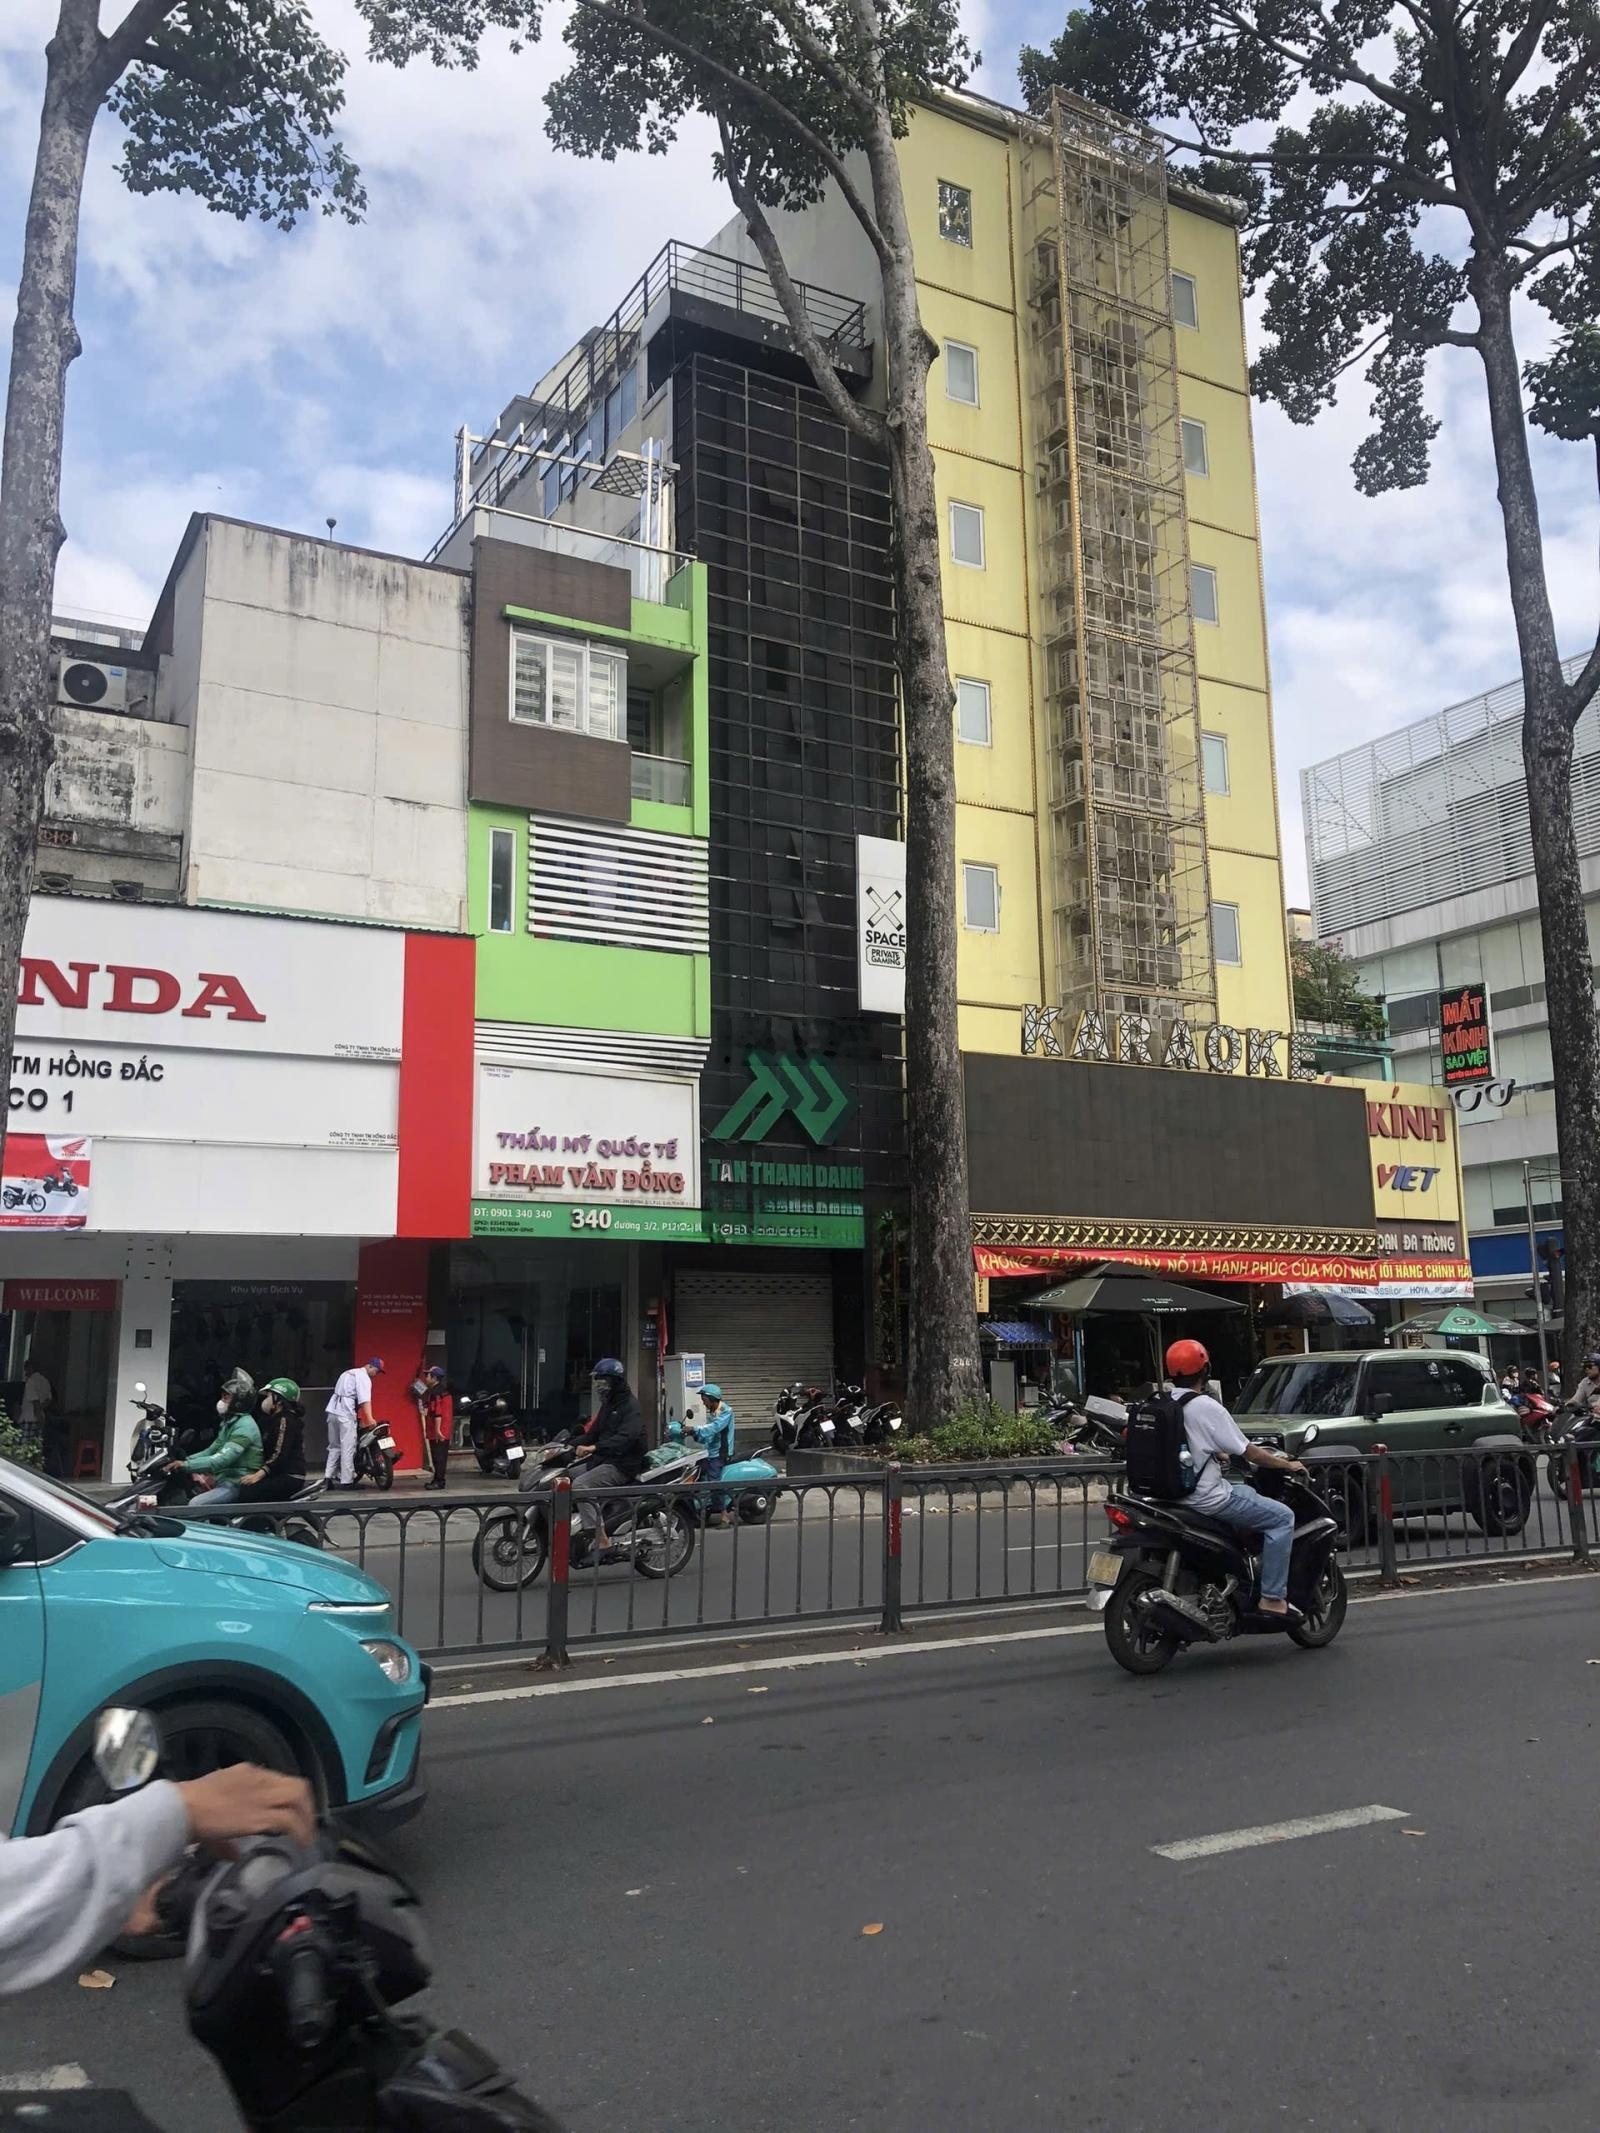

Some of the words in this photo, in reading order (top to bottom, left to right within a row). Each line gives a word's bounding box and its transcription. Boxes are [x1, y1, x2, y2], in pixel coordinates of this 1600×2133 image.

[866, 930, 905, 947] SPACE
[871, 949, 900, 959] PRIVATE
[871, 956, 901, 966] GAMING
[17, 957, 267, 1022] NDA
[1021, 1003, 1317, 1080] KARAOKE
[1443, 1024, 1488, 1054] KÍNH
[120, 1055, 164, 1082] ĐẮC
[1446, 1054, 1465, 1070] SAO
[1467, 1048, 1488, 1067] VIỆT
[62, 1090, 74, 1112] 1
[1367, 1086, 1446, 1142] KÍNH
[562, 1134, 592, 1153] MỸ
[597, 1135, 651, 1158] QUỐC
[655, 1138, 679, 1160] TẾ
[489, 1162, 565, 1191] PHẠM
[568, 1161, 618, 1190] VĂN
[750, 1162, 813, 1188] THANH
[815, 1165, 864, 1190] DANH
[474, 1208, 489, 1217] ĐT:
[490, 1208, 513, 1218] 0901
[516, 1209, 533, 1218] 340
[535, 1209, 552, 1219] 340
[571, 1208, 612, 1231] 340
[1403, 1234, 1418, 1251] ĐA
[1422, 1231, 1456, 1252] TRÒNG
[979, 1251, 1033, 1270] KHÔNG
[1167, 1253, 1189, 1273] NỔ
[1192, 1256, 1208, 1274] LÀ
[1212, 1259, 1249, 1278] HẠNH
[1251, 1258, 1288, 1276] PHÚC
[1291, 1257, 1320, 1277] CỦA
[1322, 1262, 1347, 1282] MỌI
[1395, 1262, 1423, 1279] HÀNG
[1425, 1262, 1456, 1279] CHÍNH
[20, 1288, 100, 1301] WELCOME
[230, 1285, 248, 1294] Khu
[1409, 1286, 1430, 1294] HOYA
